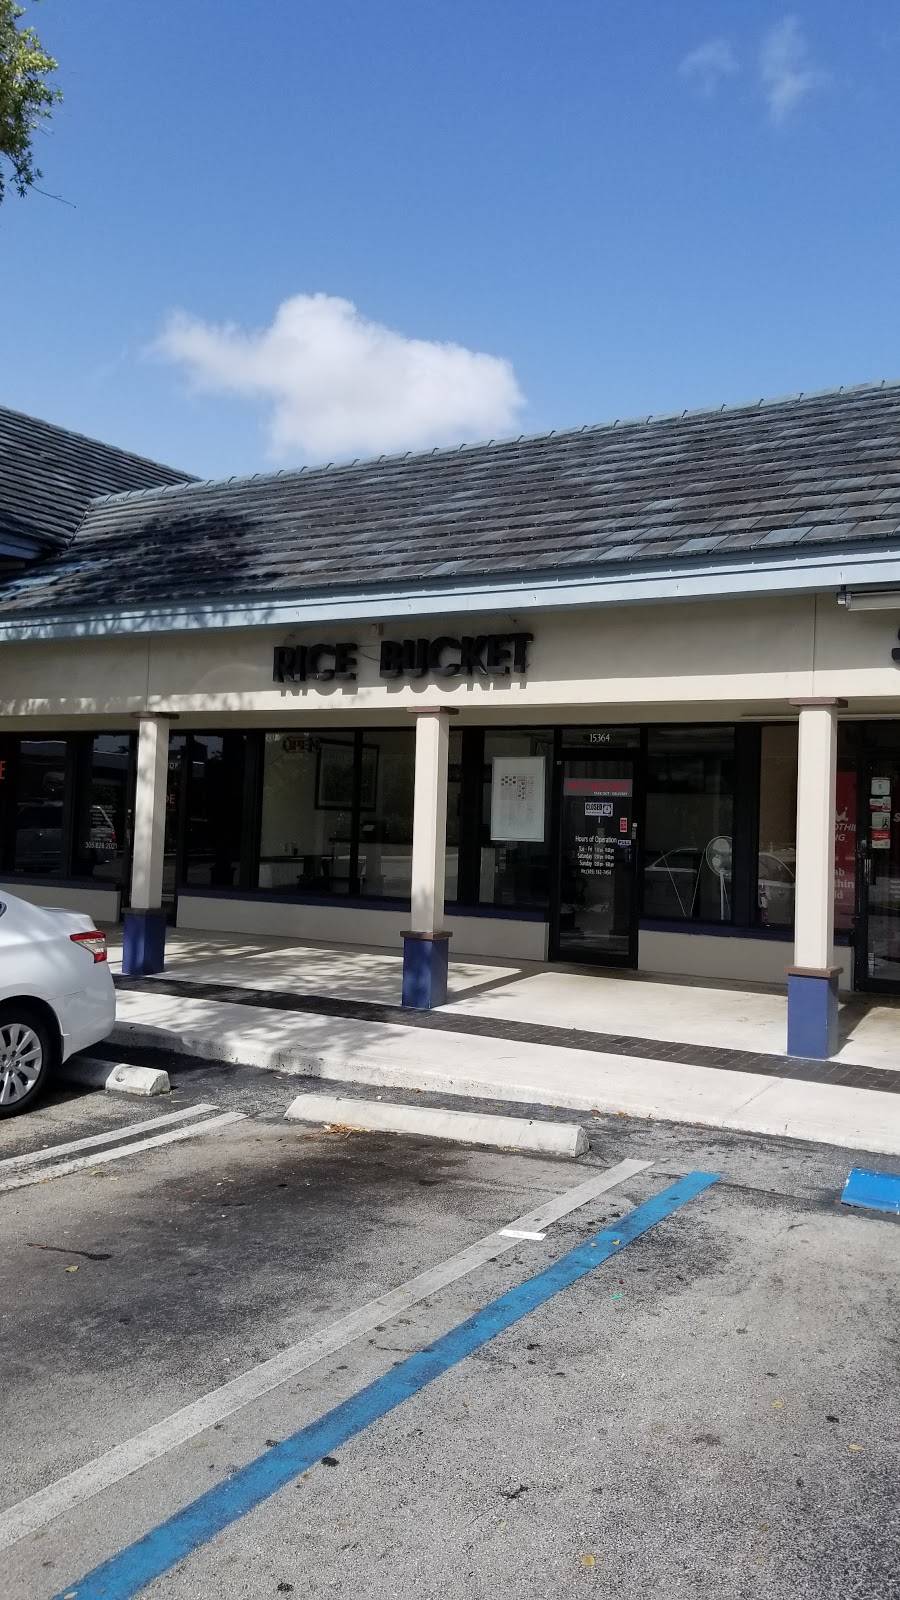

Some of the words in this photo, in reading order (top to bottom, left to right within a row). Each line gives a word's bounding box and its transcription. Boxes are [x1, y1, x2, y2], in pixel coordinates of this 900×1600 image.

[273, 643, 358, 683] RICE
[379, 632, 534, 679] BUCKET
[590, 733, 610, 743] 15364
[585, 803, 603, 811] CLOSED
[575, 835, 588, 843] Hours
[589, 835, 594, 843] of
[595, 835, 617, 844] Operation
[577, 853, 593, 861] Saturday
[579, 860, 593, 868] Sunday
